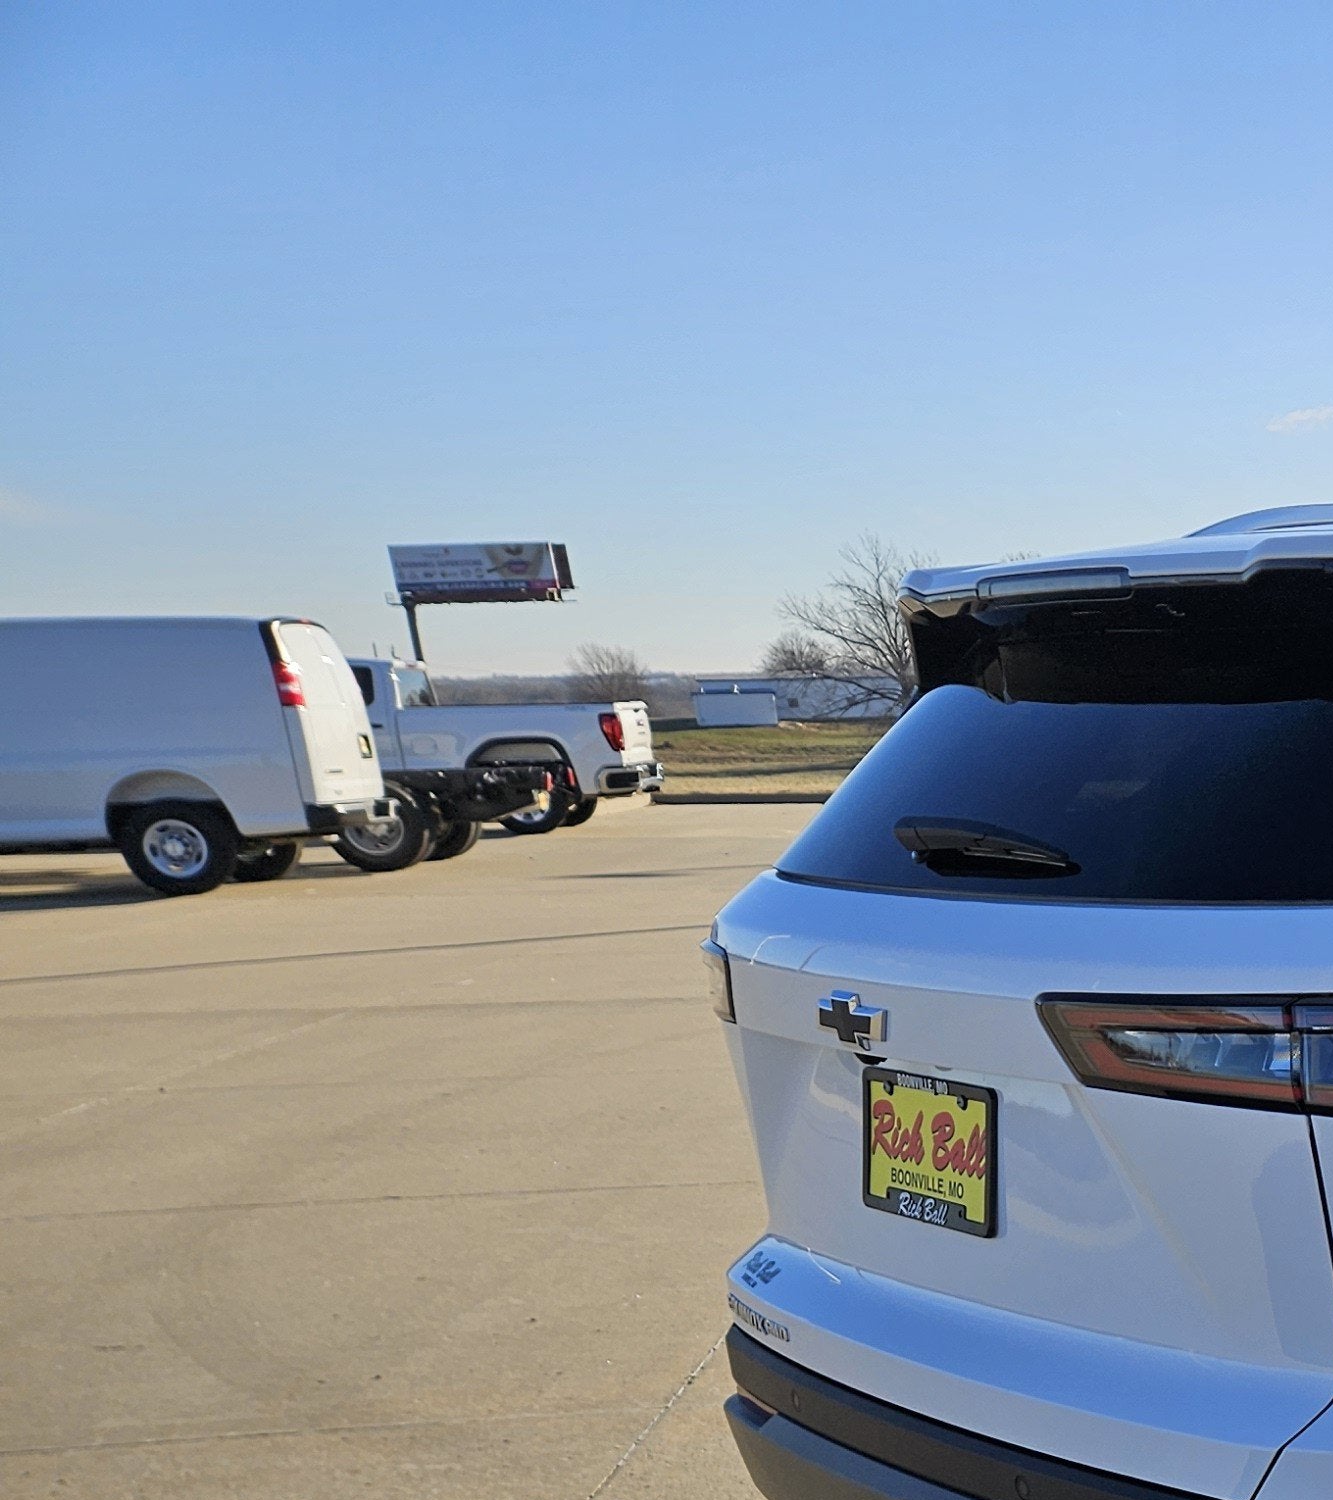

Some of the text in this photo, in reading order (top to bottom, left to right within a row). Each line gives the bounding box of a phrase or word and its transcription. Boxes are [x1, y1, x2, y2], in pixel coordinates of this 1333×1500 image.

[936, 1080, 948, 1095] MO
[872, 1099, 987, 1180] Rick Ball
[891, 1167, 964, 1199] BOONVILLE, MO
[898, 1191, 950, 1225] Rick Ball
